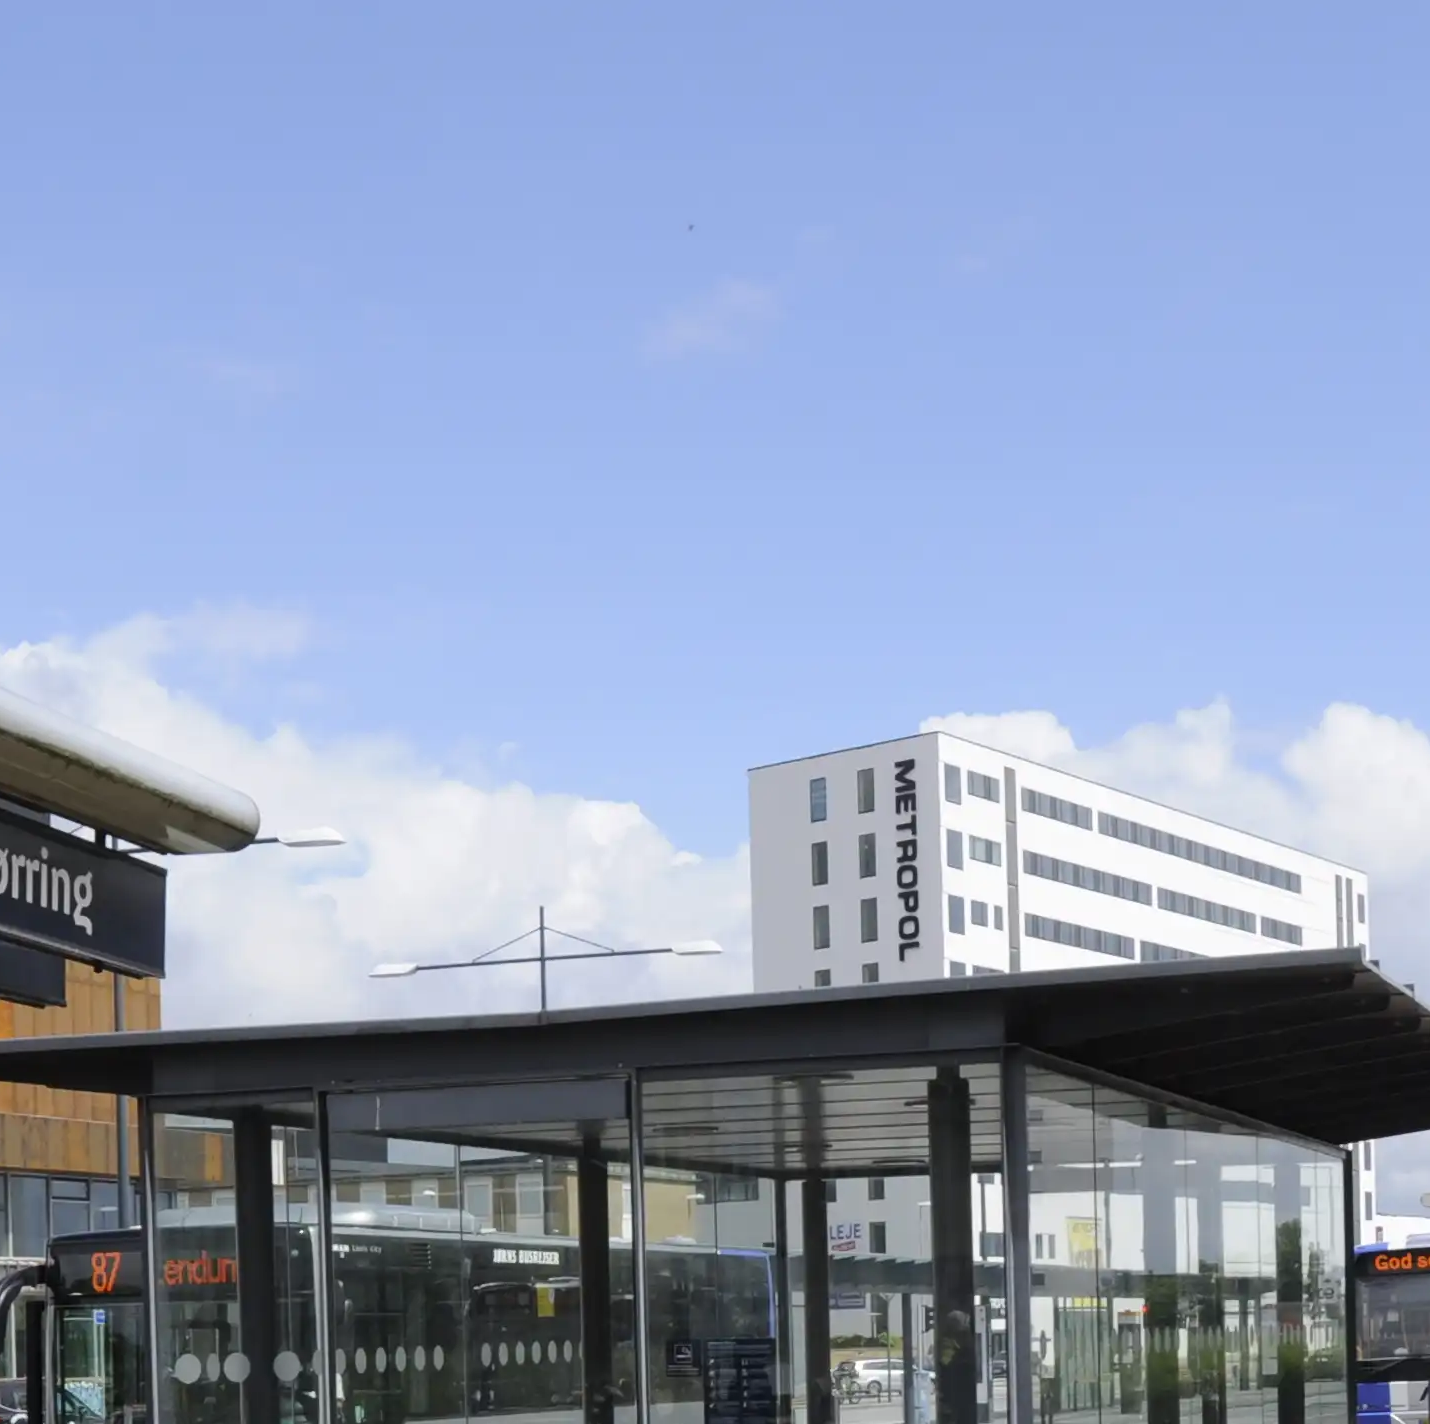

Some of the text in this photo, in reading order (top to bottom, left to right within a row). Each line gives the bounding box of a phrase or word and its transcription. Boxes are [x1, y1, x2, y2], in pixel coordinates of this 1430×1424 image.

[894, 758, 921, 963] METROPOL
[829, 1223, 862, 1240] LEJE
[91, 1252, 122, 1293] 87
[1375, 1252, 1413, 1271] God
